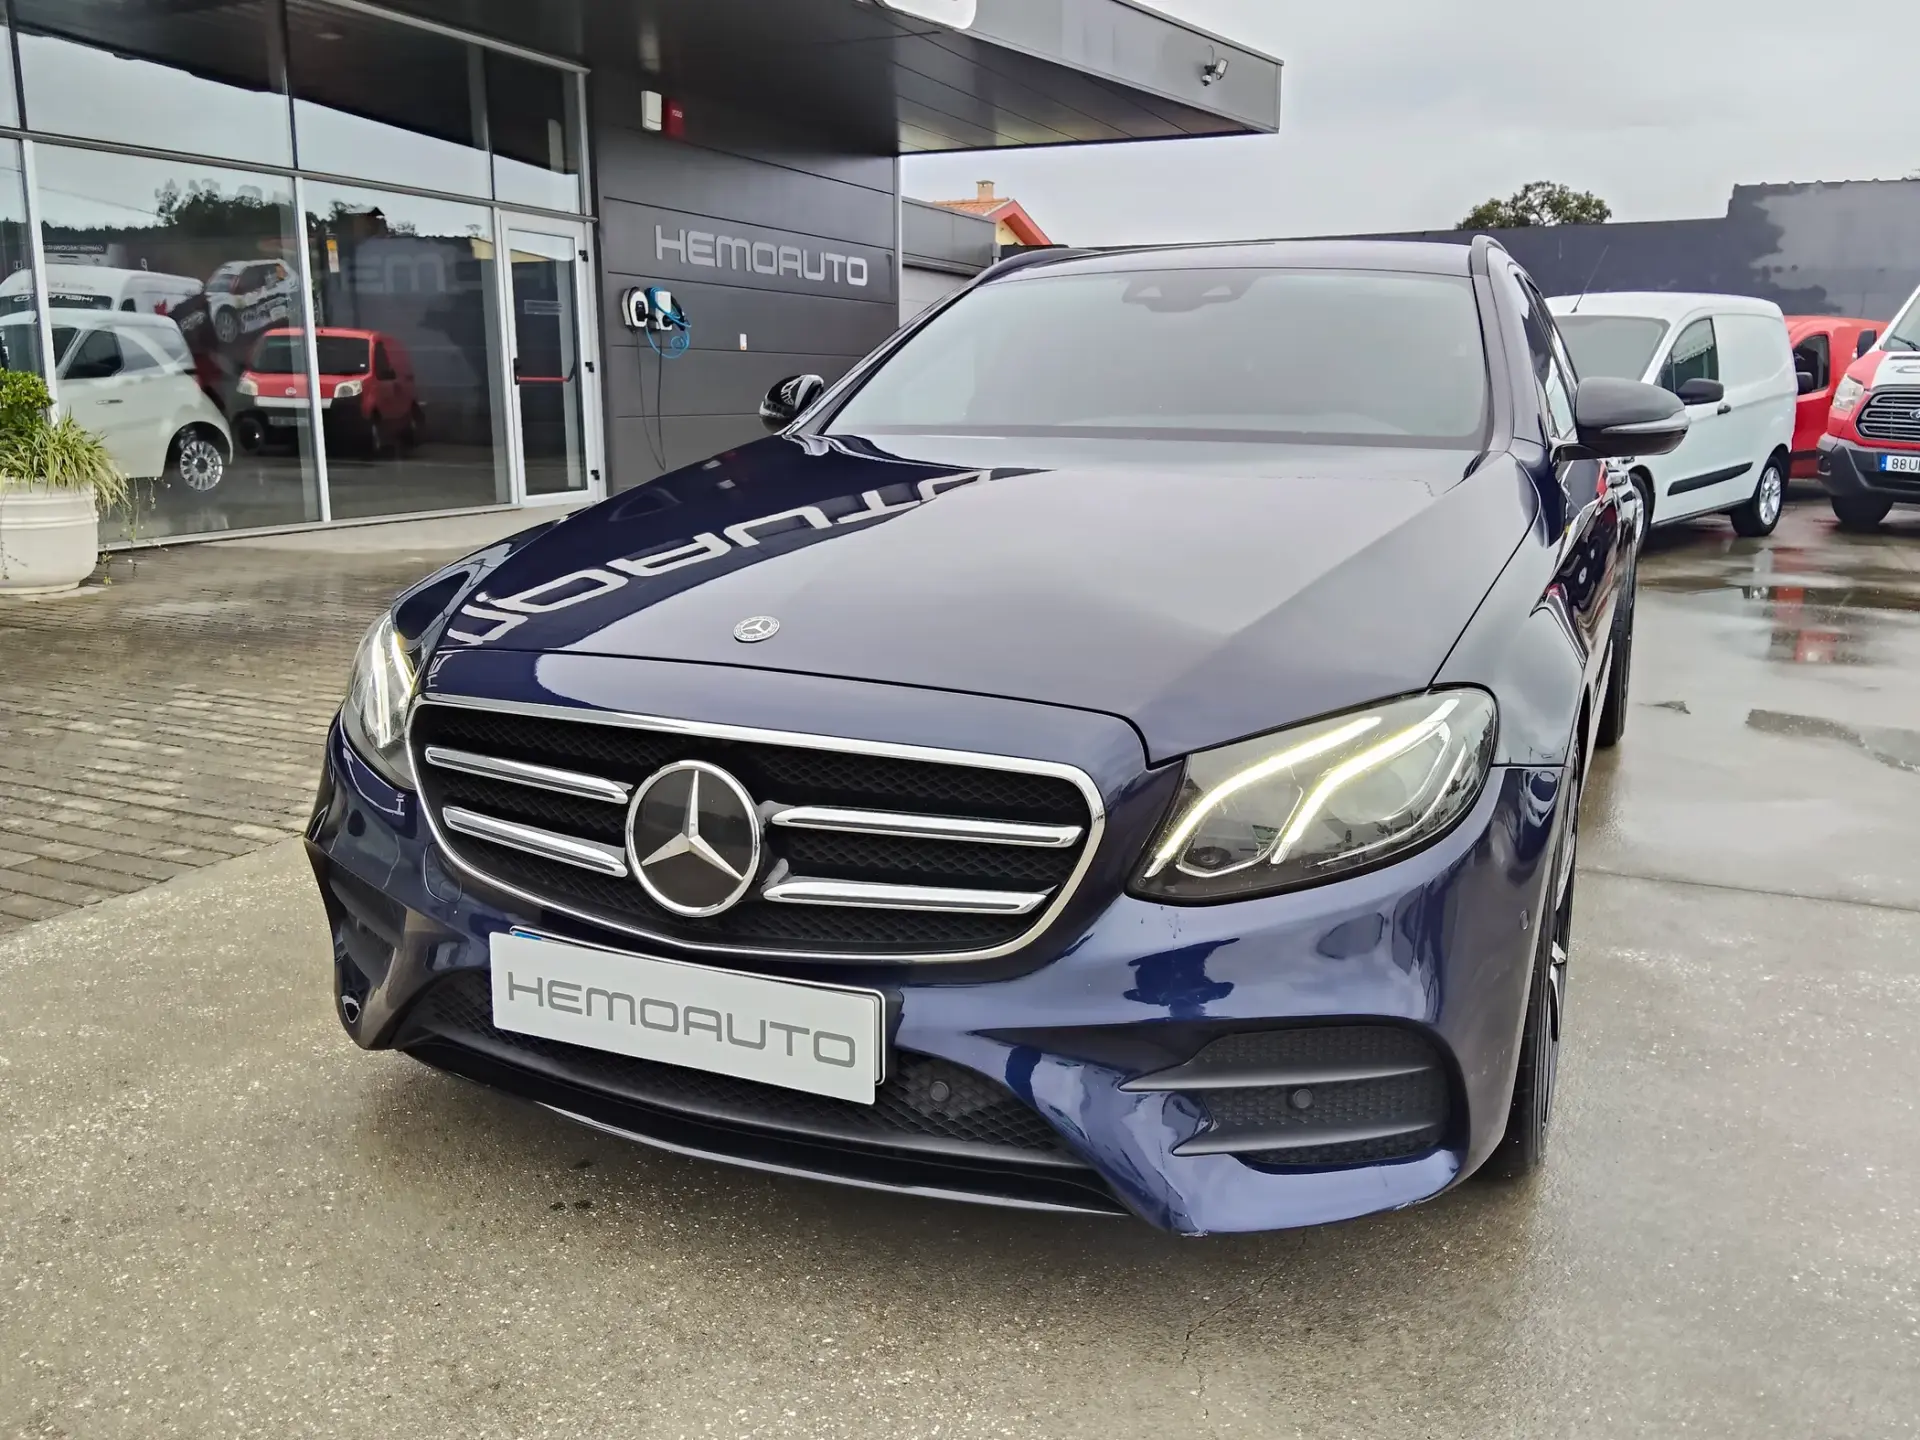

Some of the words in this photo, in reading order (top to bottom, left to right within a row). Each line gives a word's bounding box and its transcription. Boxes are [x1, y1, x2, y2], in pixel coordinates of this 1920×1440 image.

[655, 225, 869, 287] HEMOAUTO
[1891, 457, 1906, 470] 88
[507, 971, 856, 1068] HEMOAUTO
